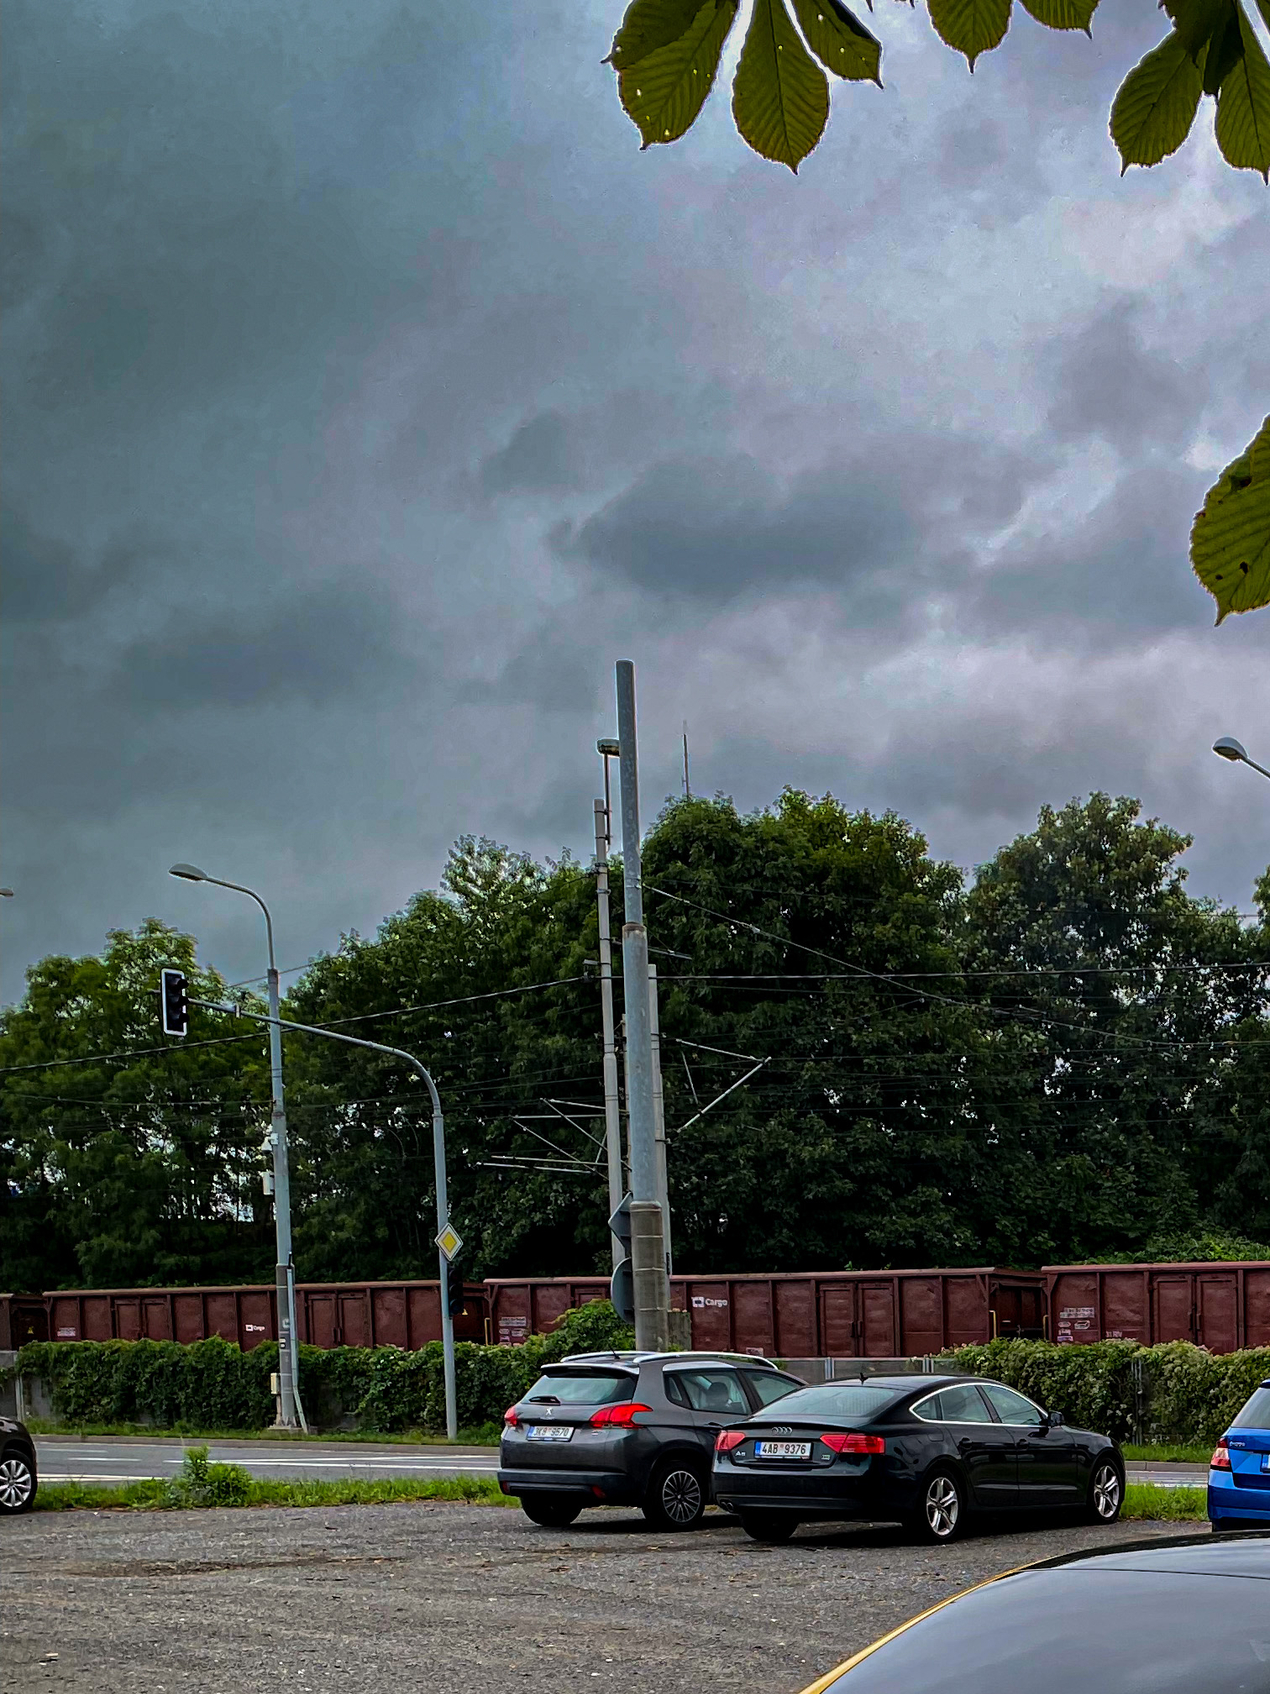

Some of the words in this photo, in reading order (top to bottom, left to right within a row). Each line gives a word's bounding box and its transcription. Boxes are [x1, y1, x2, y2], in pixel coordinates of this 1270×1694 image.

[705, 1298, 728, 1308] Cargo
[762, 1443, 779, 1454] 4AB
[784, 1444, 807, 1455] 9376
